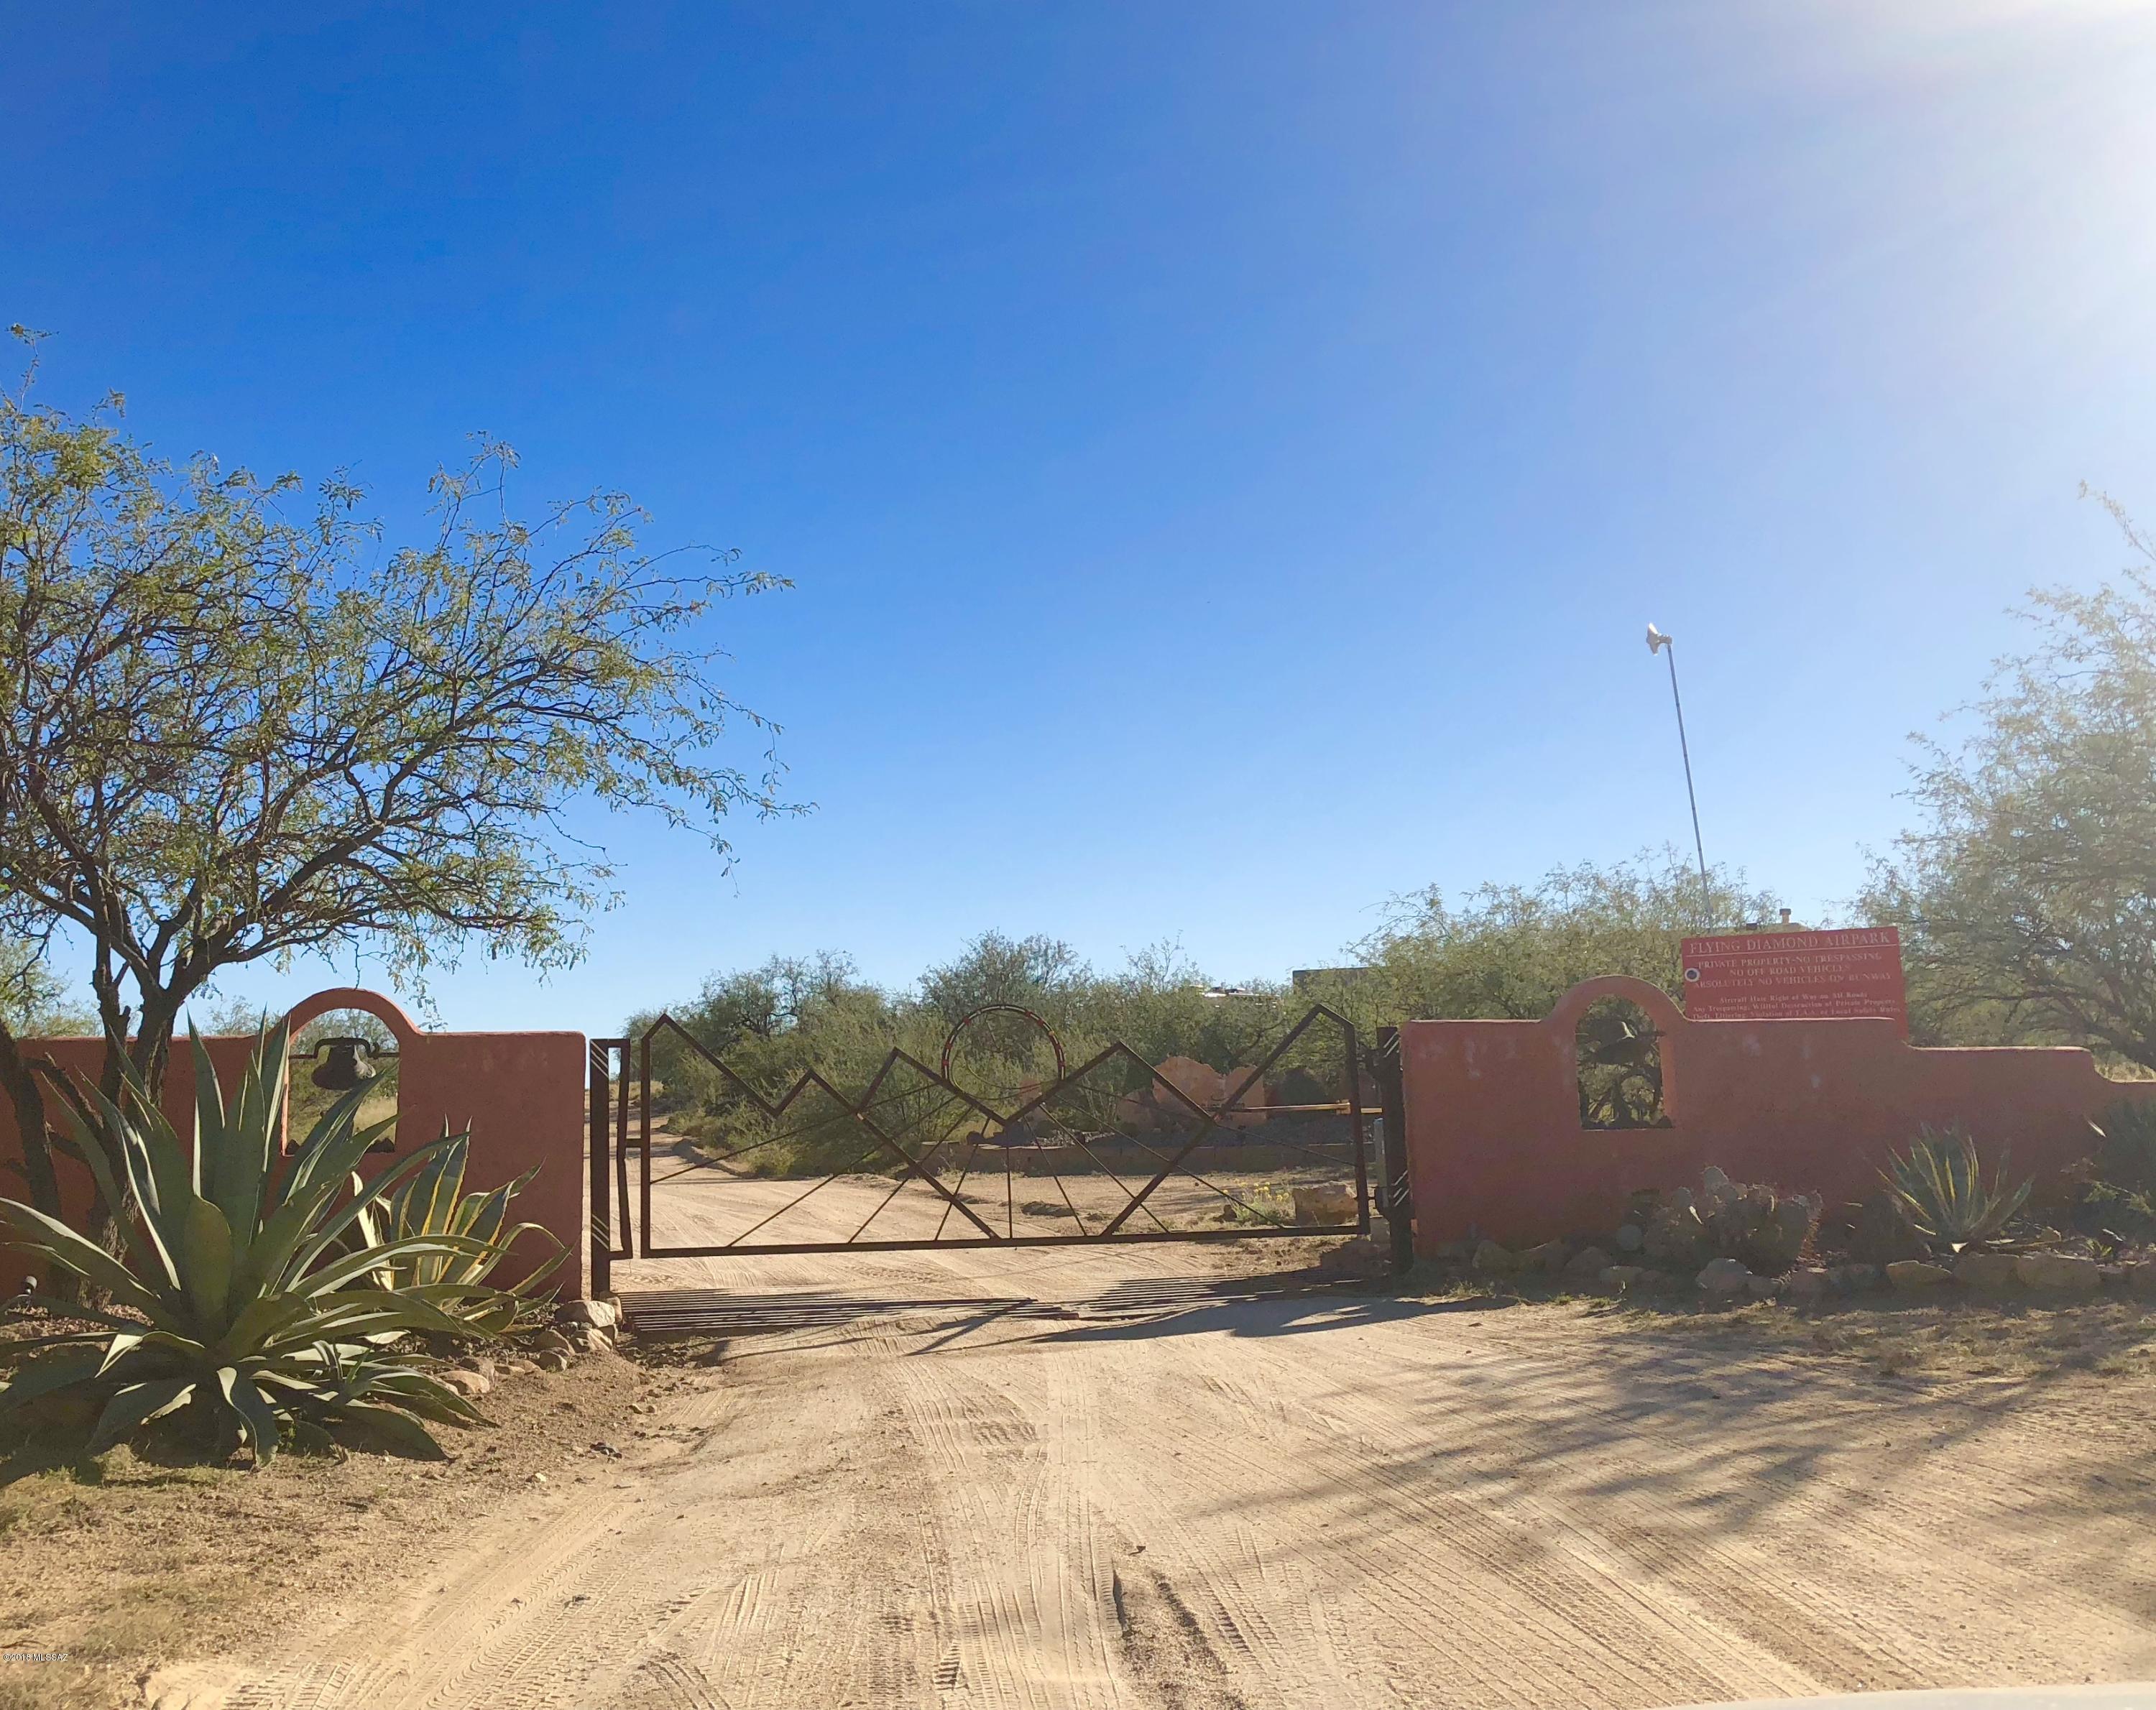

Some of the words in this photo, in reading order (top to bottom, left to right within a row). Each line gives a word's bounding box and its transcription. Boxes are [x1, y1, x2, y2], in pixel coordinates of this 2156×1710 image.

[1690, 941, 1740, 953] FLYING
[1747, 936, 1818, 951] DIAMOND
[1827, 933, 1890, 946] AIRPARK
[1697, 959, 1737, 969] PRIVATE
[1816, 953, 1881, 962] TRESPASSING
[1747, 968, 1764, 976] OFF
[1800, 964, 1849, 973] VEHICLES
[1694, 979, 1754, 988] ABSOLUTELY
[1776, 975, 1825, 984] VEHICLES
[1849, 972, 1891, 981] RUNWAY
[1770, 994, 1789, 1002] Right
